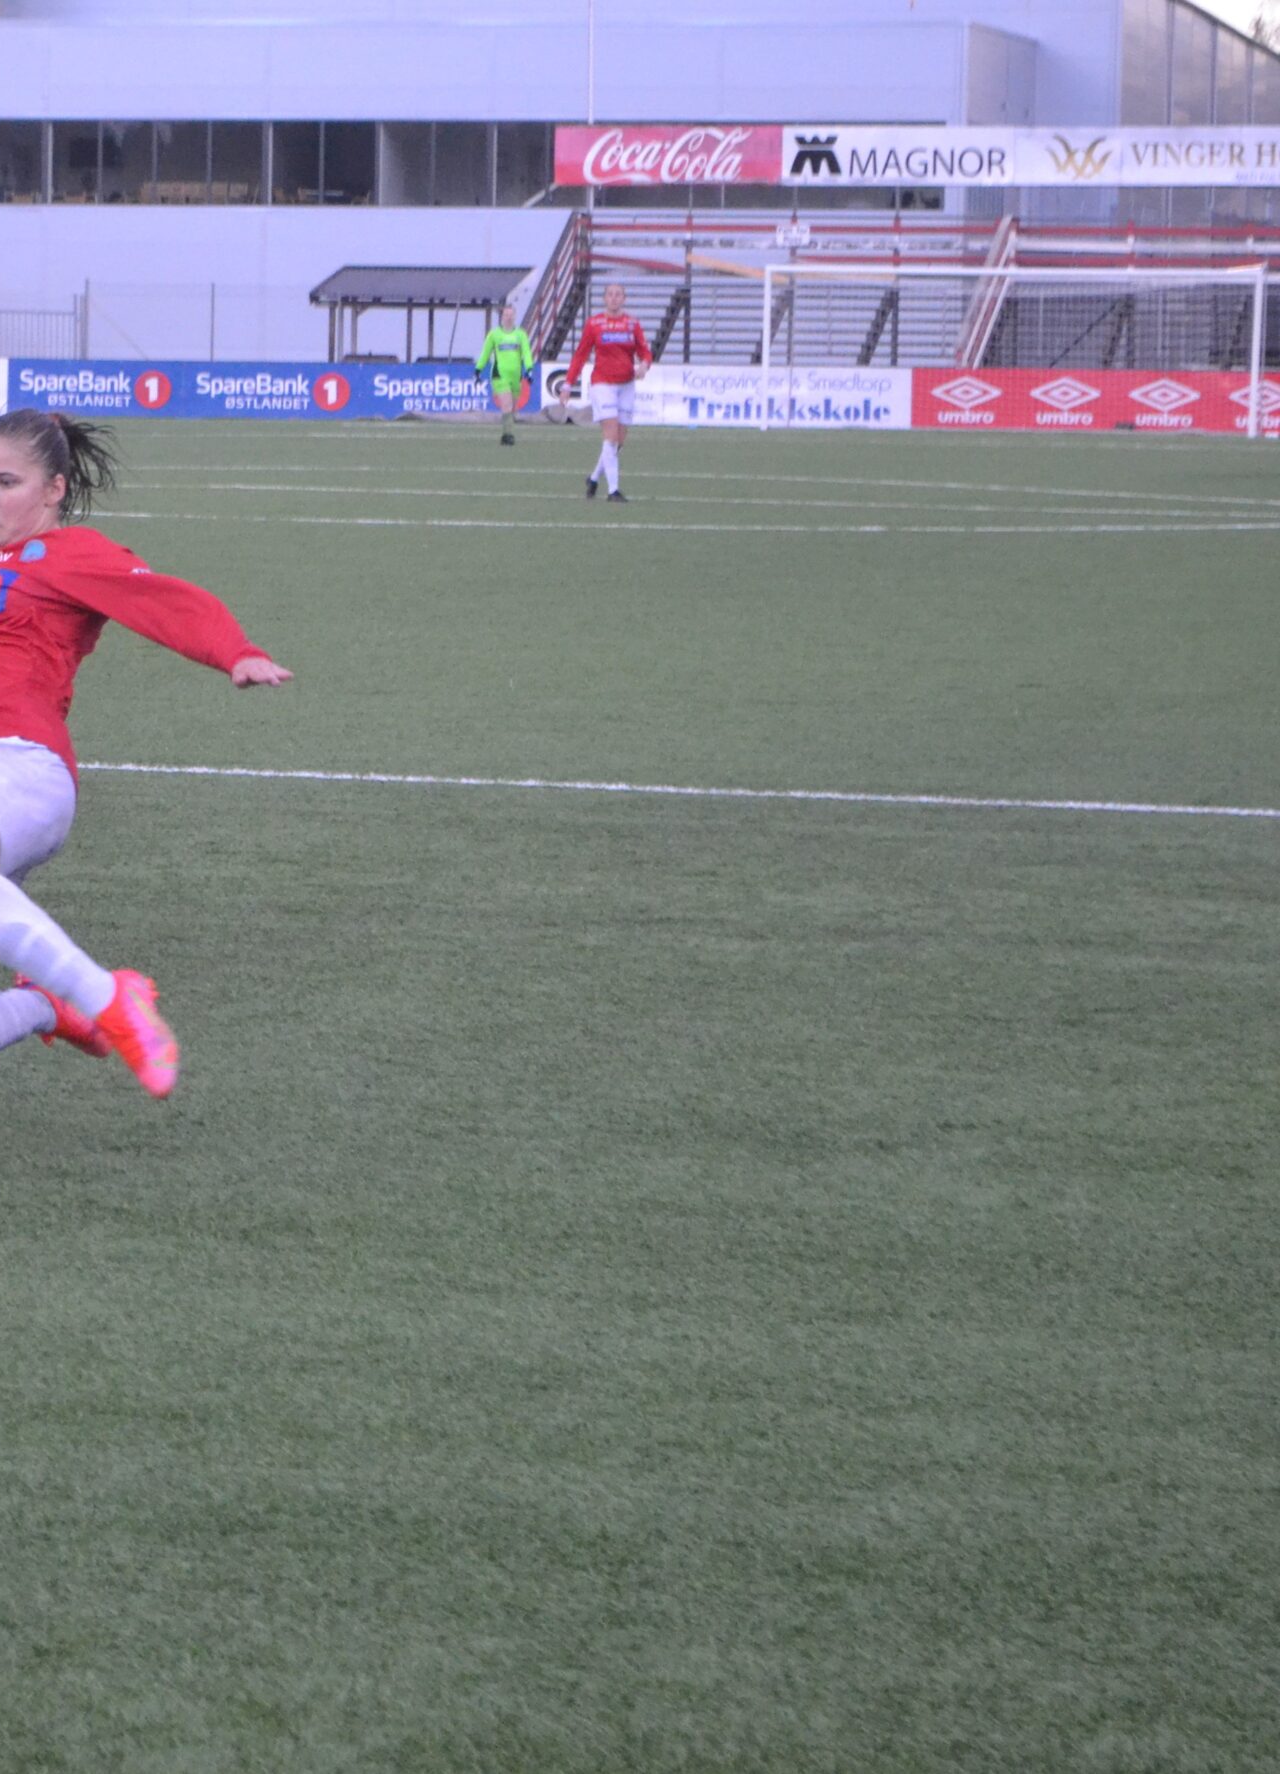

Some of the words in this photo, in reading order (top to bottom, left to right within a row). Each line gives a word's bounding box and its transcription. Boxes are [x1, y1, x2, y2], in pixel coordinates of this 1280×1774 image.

[583, 127, 753, 184] Coca-Cola
[849, 147, 1006, 178] MAGNOR
[1131, 140, 1246, 168] VINGER
[1256, 140, 1280, 168] H
[20, 369, 131, 395] SpareBank
[145, 377, 159, 403] 1
[196, 372, 310, 398] SpareBank
[323, 379, 338, 405] 1
[373, 374, 489, 400] SpareBank
[47, 394, 131, 408] ØSTLANDET
[225, 397, 311, 411] ØSTLANDET
[403, 398, 490, 411] ØSTLANDET
[683, 397, 890, 421] Trafikkskole
[937, 411, 995, 425] umbro
[1035, 411, 1094, 426] umbro
[1135, 413, 1193, 427] umbro
